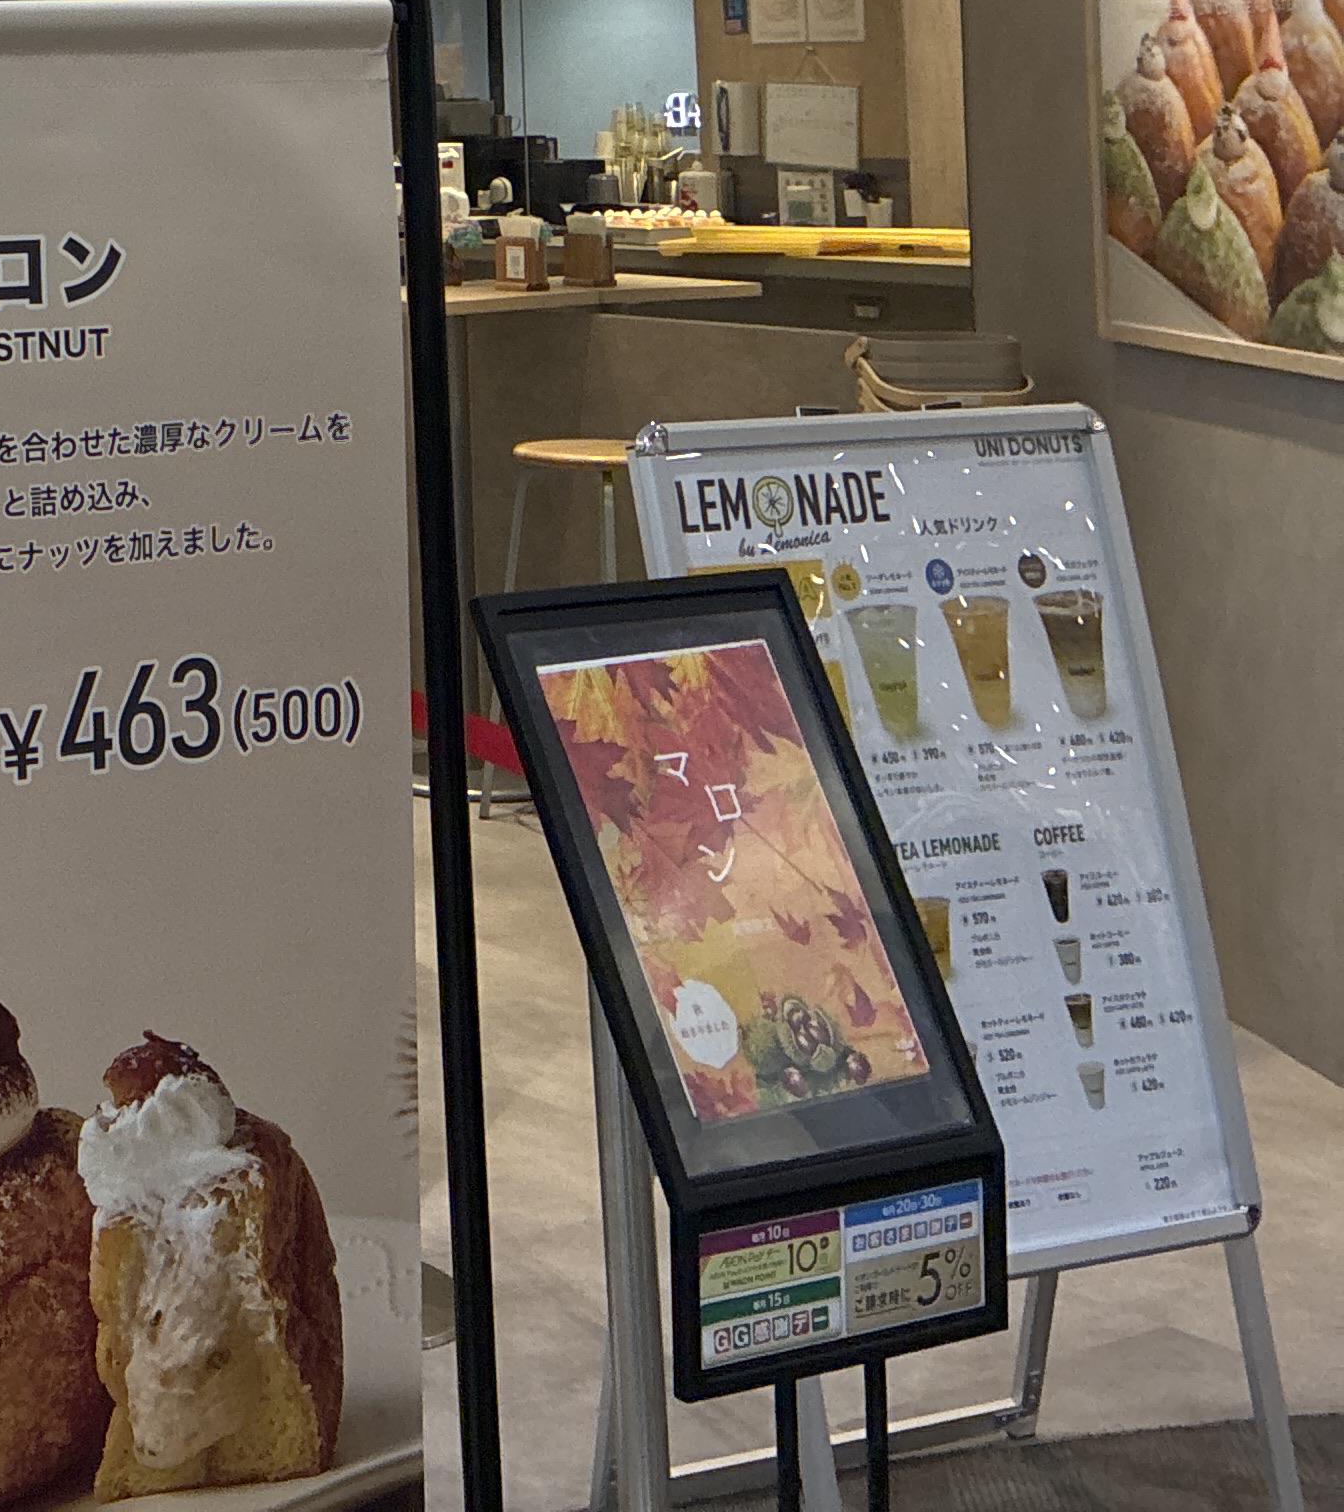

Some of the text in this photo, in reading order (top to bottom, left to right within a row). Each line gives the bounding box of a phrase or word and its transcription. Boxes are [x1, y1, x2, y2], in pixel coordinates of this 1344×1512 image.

[974, 435, 1083, 457] UNI DONUTS
[920, 516, 998, 536] 人気ドリンク
[922, 832, 1001, 859] LEMONADE
[1033, 824, 1086, 847] COFFEE
[945, 1281, 973, 1301] OFF
